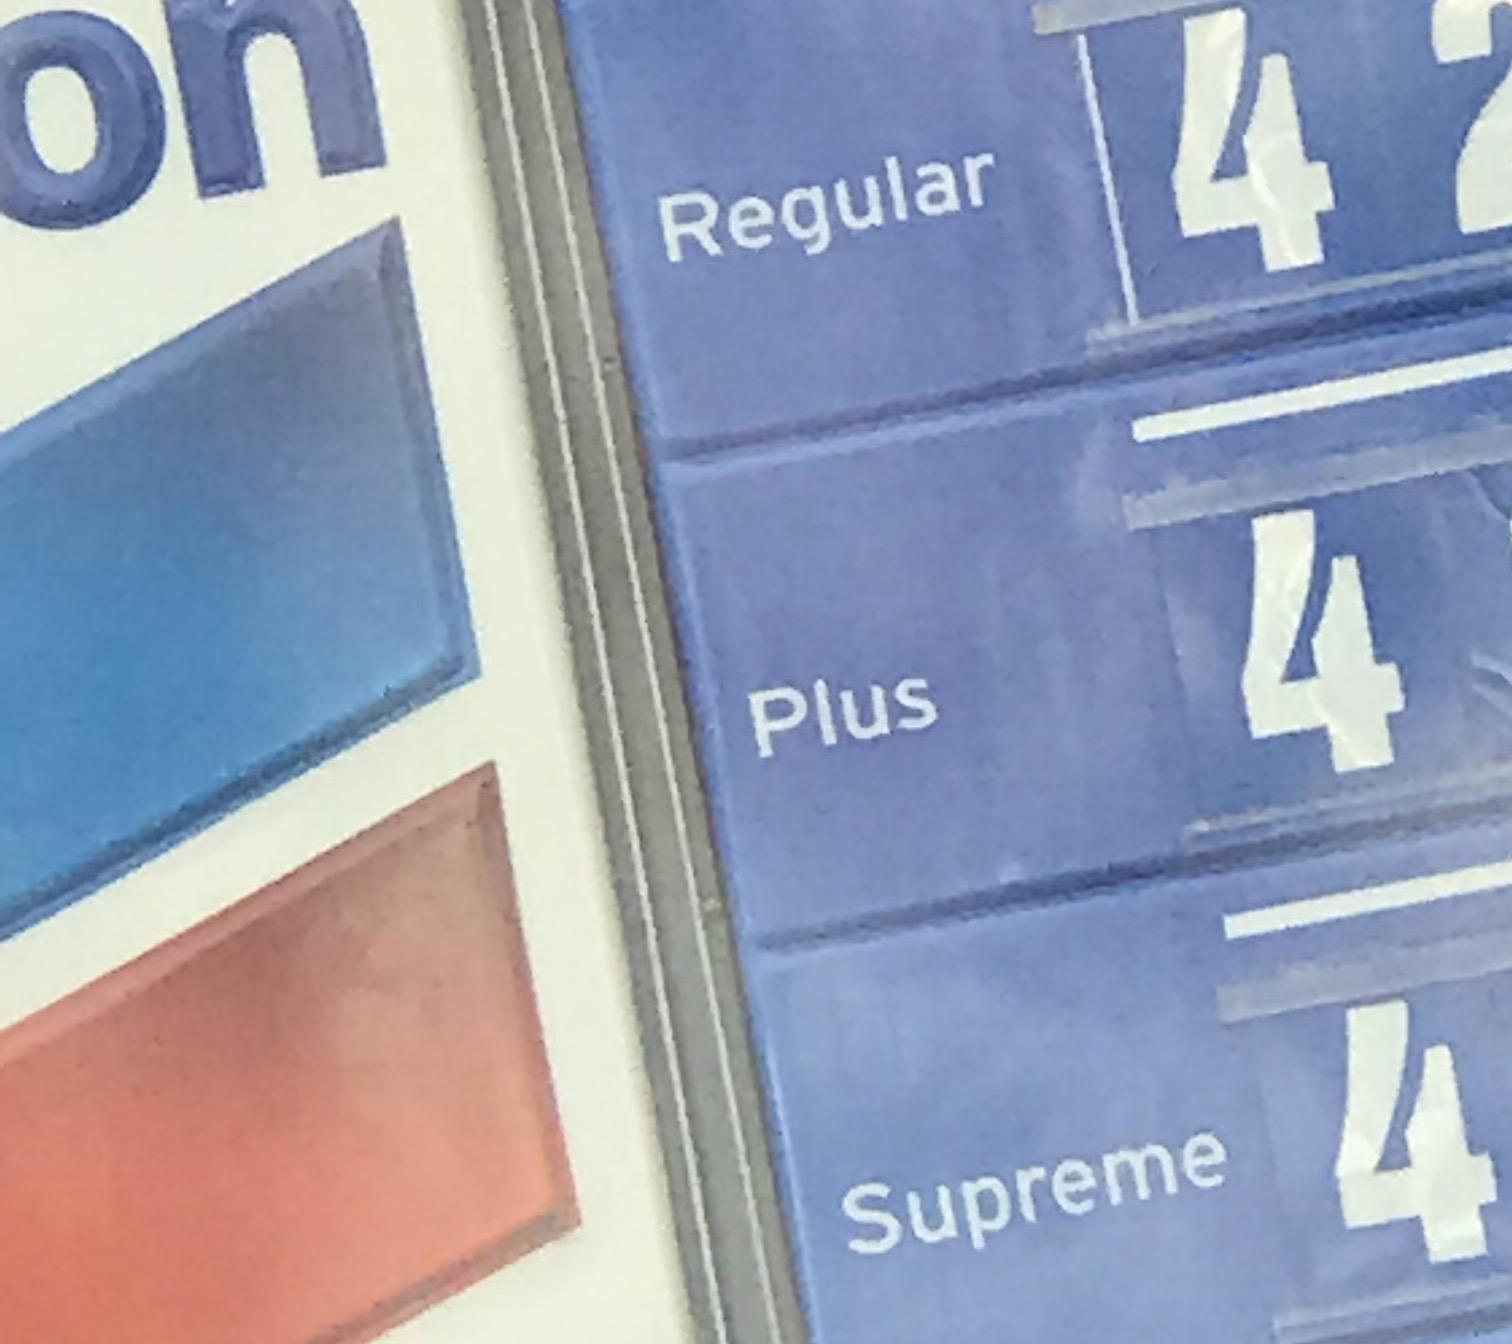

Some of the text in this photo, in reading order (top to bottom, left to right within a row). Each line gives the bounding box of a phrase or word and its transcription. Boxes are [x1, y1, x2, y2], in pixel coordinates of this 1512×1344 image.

[657, 152, 995, 264] Regular
[746, 677, 939, 760] Plus
[841, 1132, 1228, 1255] Supreme
